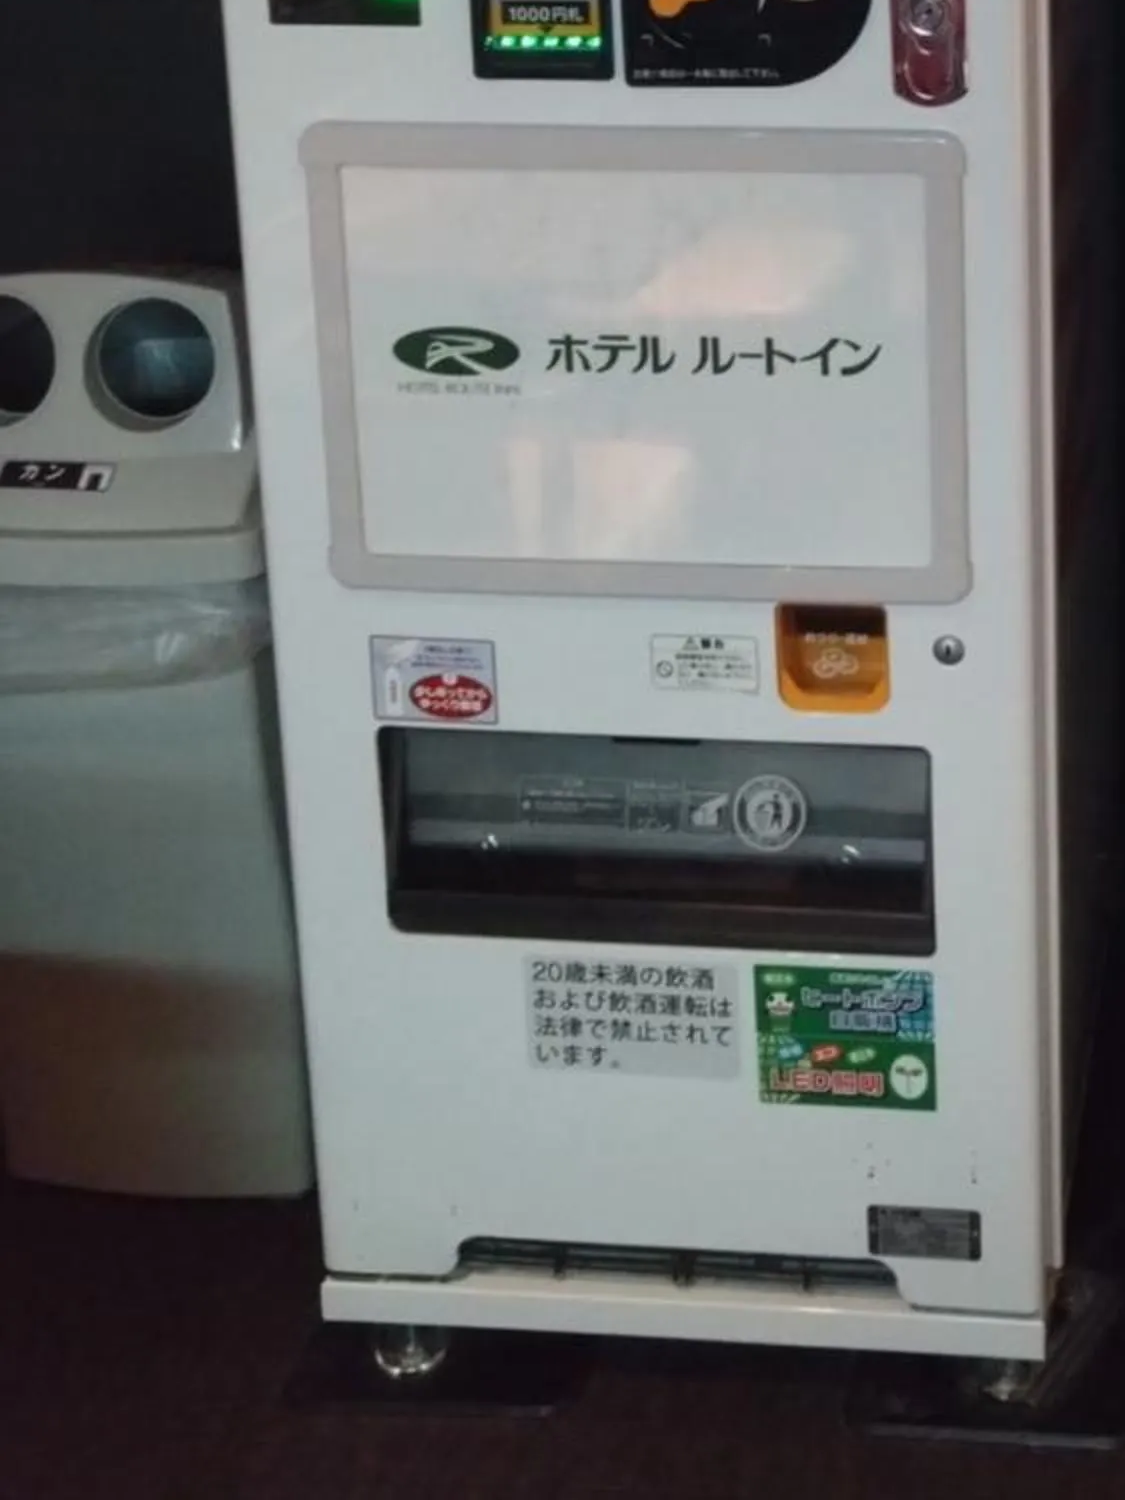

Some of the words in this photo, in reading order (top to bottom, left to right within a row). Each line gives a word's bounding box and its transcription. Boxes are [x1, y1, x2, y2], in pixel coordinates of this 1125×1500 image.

[546, 333, 676, 373] ホテル
[691, 335, 882, 376] ルートイン
[19, 464, 66, 481] カン
[532, 961, 715, 990] 20歳未満の飲酒
[533, 989, 733, 1018] および飲酒運転は
[534, 1014, 733, 1047] 法律で禁止されて
[535, 1044, 621, 1069] います。
